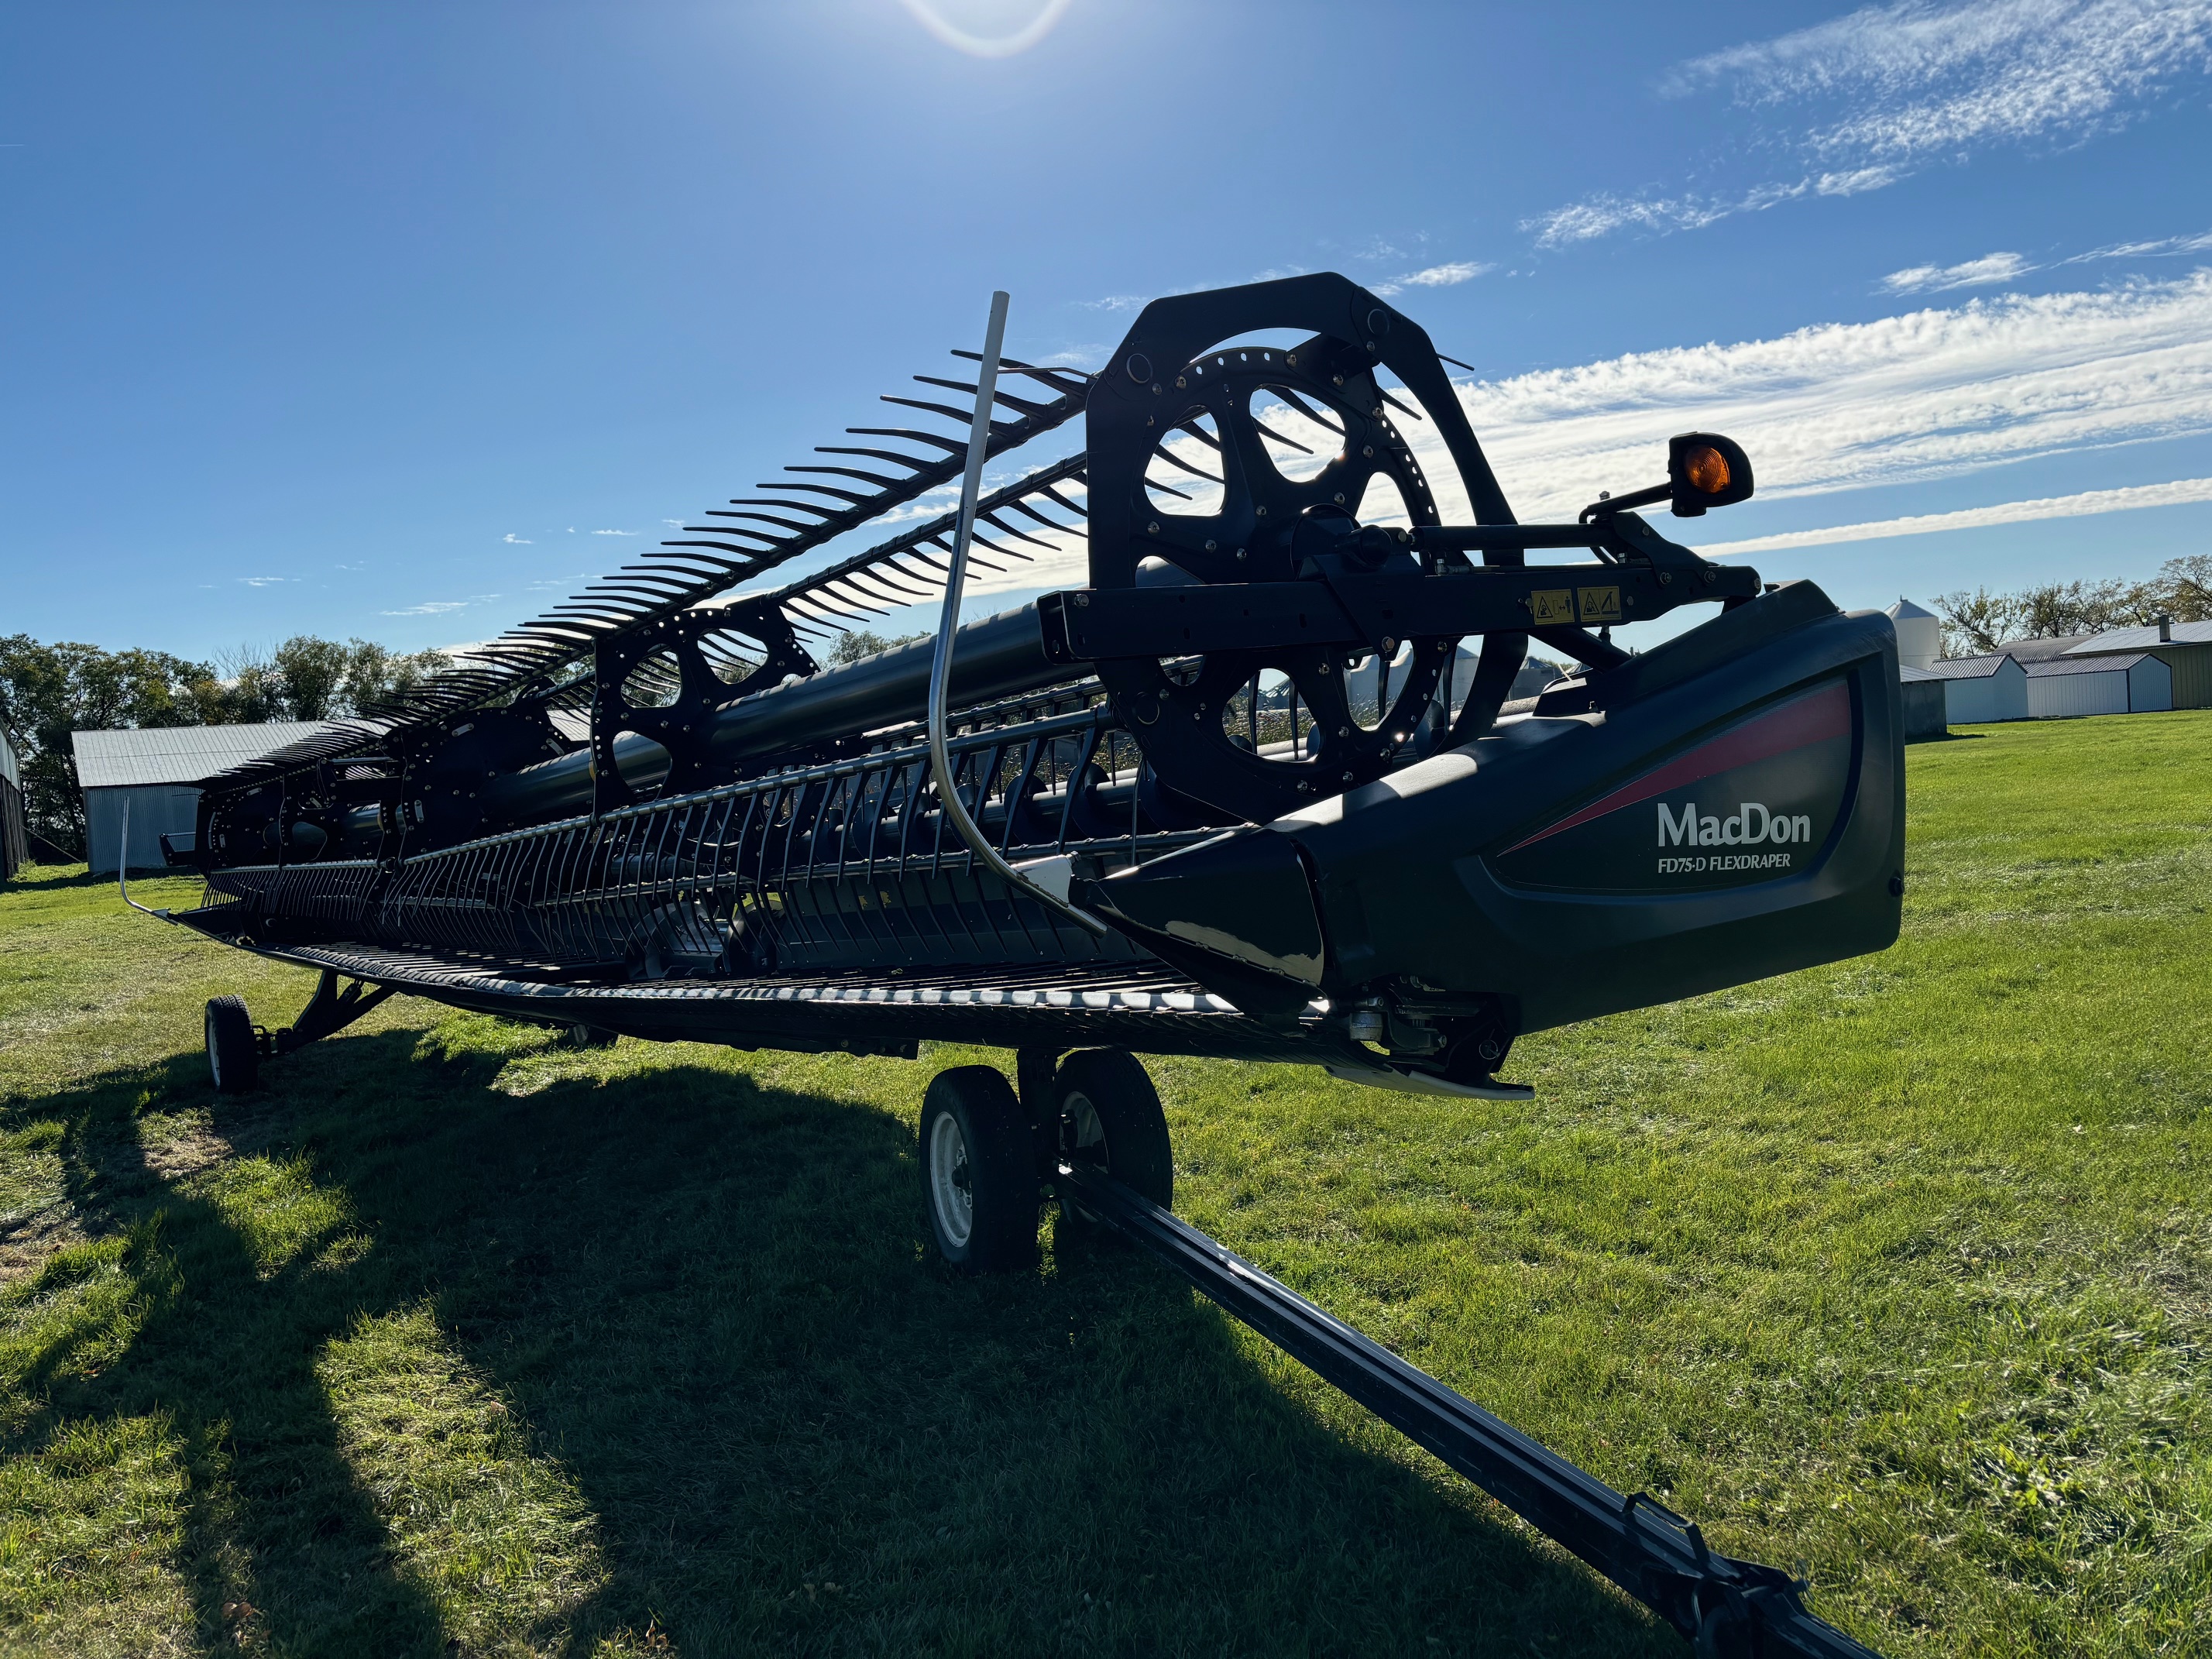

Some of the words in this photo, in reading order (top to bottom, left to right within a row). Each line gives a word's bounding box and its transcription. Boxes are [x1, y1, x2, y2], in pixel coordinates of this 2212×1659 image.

[1657, 802, 1811, 847] MacDon
[1657, 857, 1707, 874] FD75-D
[1709, 853, 1791, 871] FLEXDRAPER
